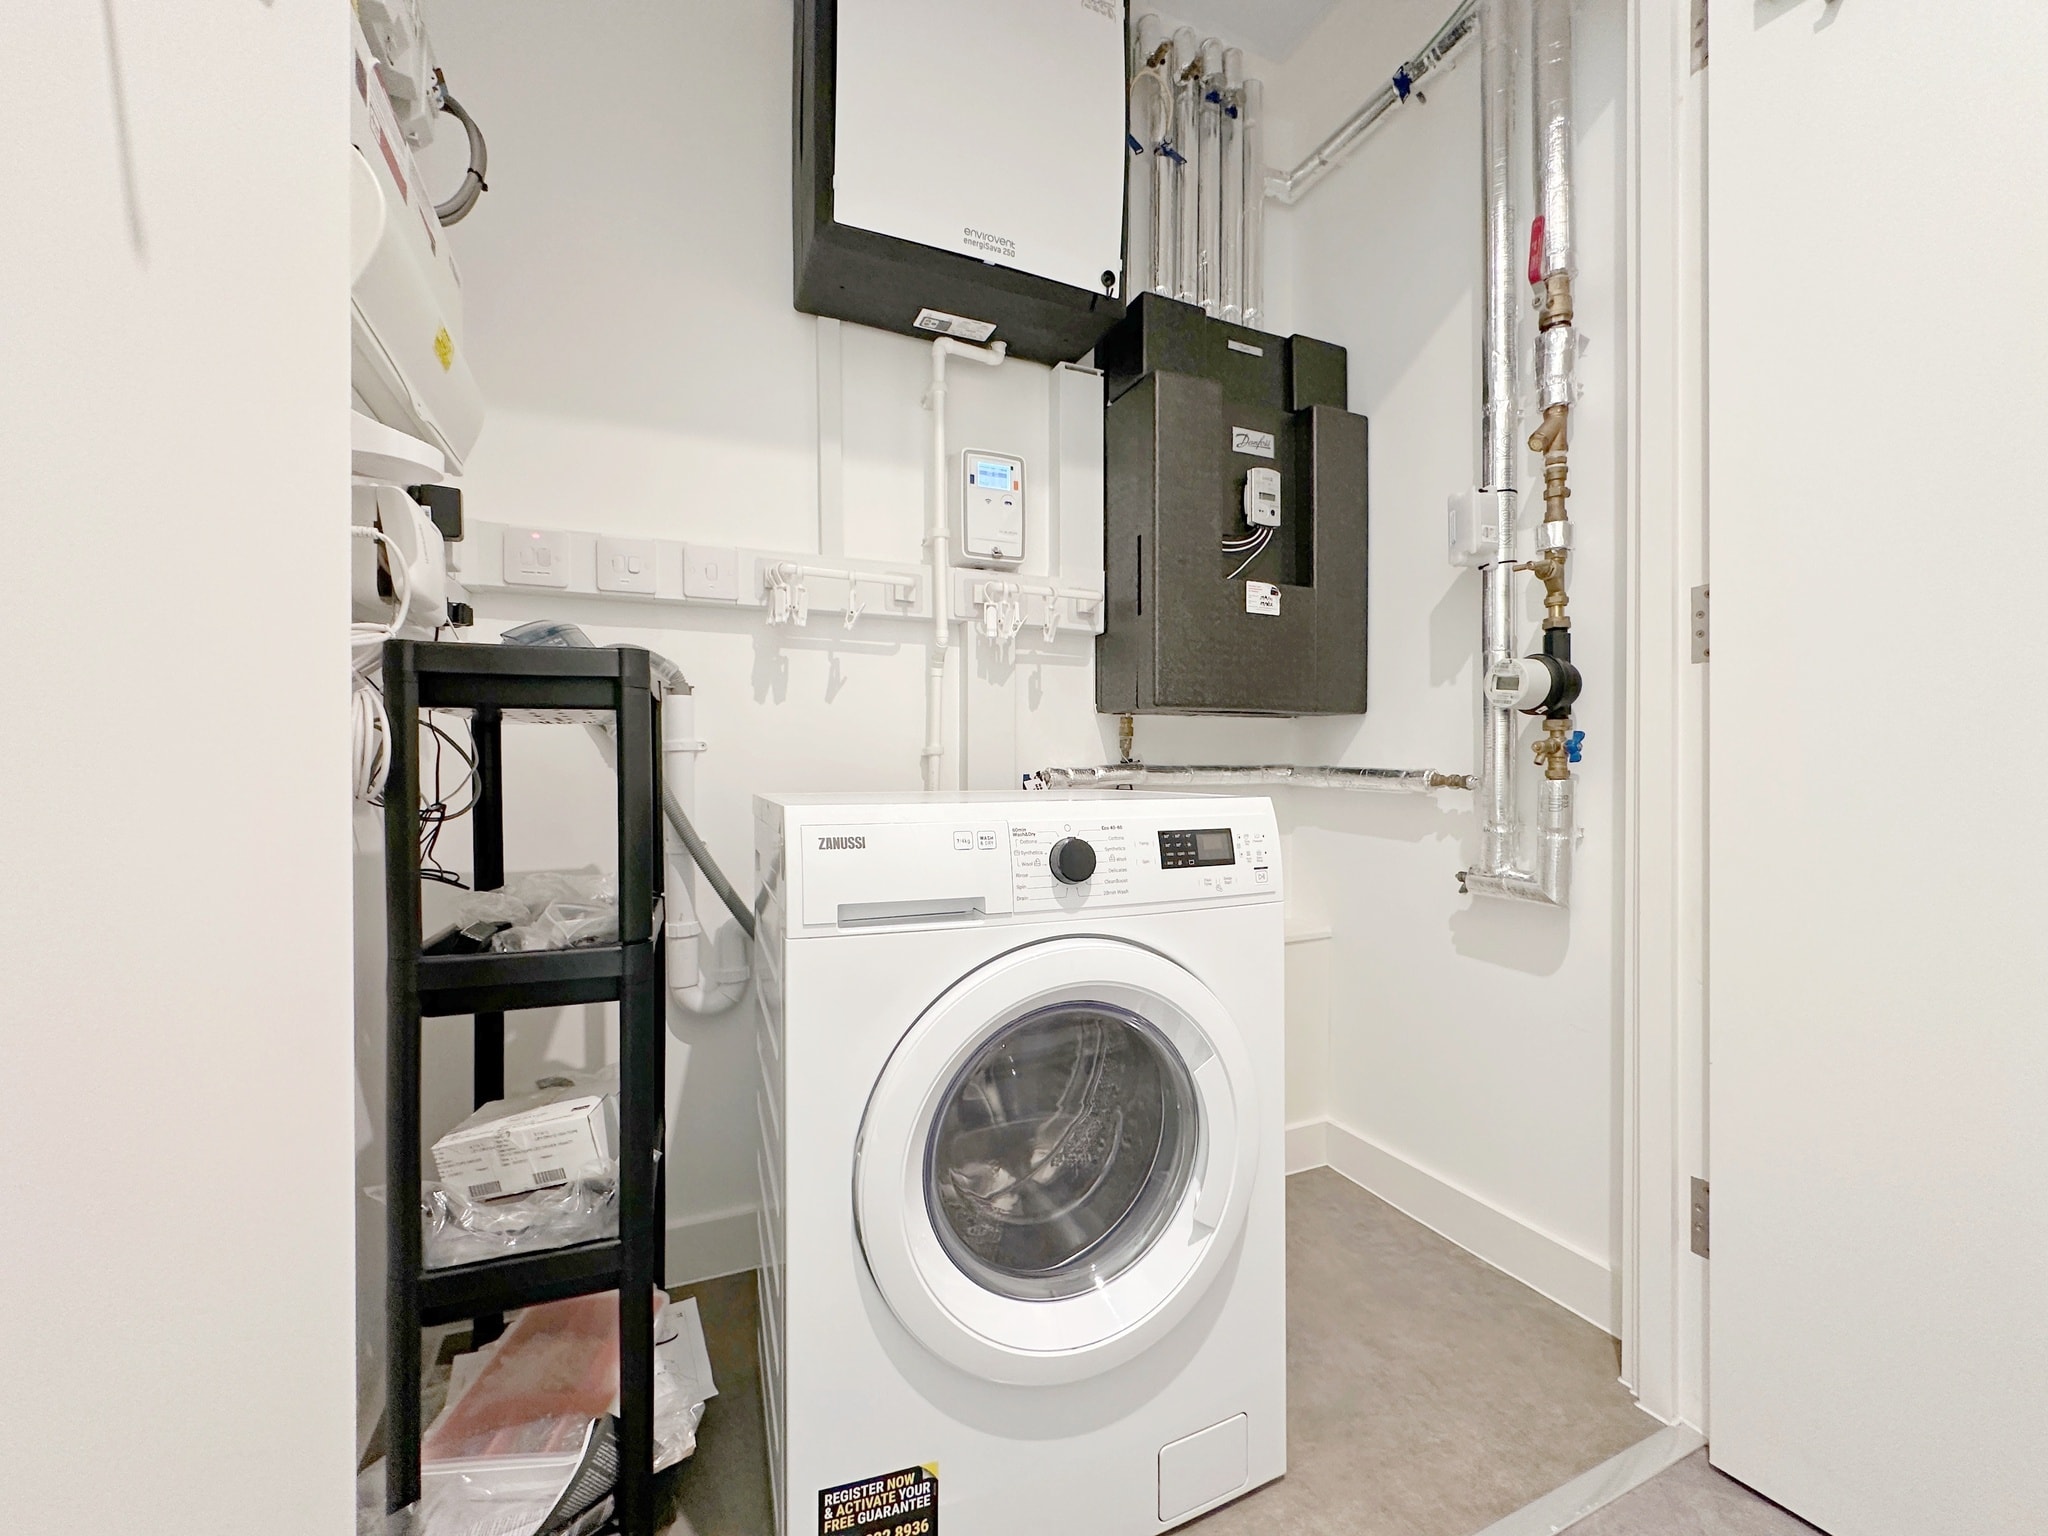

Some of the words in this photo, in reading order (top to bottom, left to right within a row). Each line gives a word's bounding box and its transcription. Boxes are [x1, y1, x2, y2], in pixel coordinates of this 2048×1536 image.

[963, 227, 1016, 250] envirovent
[963, 237, 1002, 254] energiSava
[1002, 248, 1016, 258] 250
[818, 836, 866, 850] ZANUSSI
[824, 1481, 885, 1507] REGISTER
[886, 1472, 915, 1491] NOW
[824, 1507, 834, 1520] &
[836, 1491, 897, 1518] ACTIVATE
[898, 1481, 931, 1501] YOUR
[824, 1514, 856, 1534] FREE
[857, 1494, 931, 1525] GUARANTEE
[894, 1518, 930, 1536] 8936
